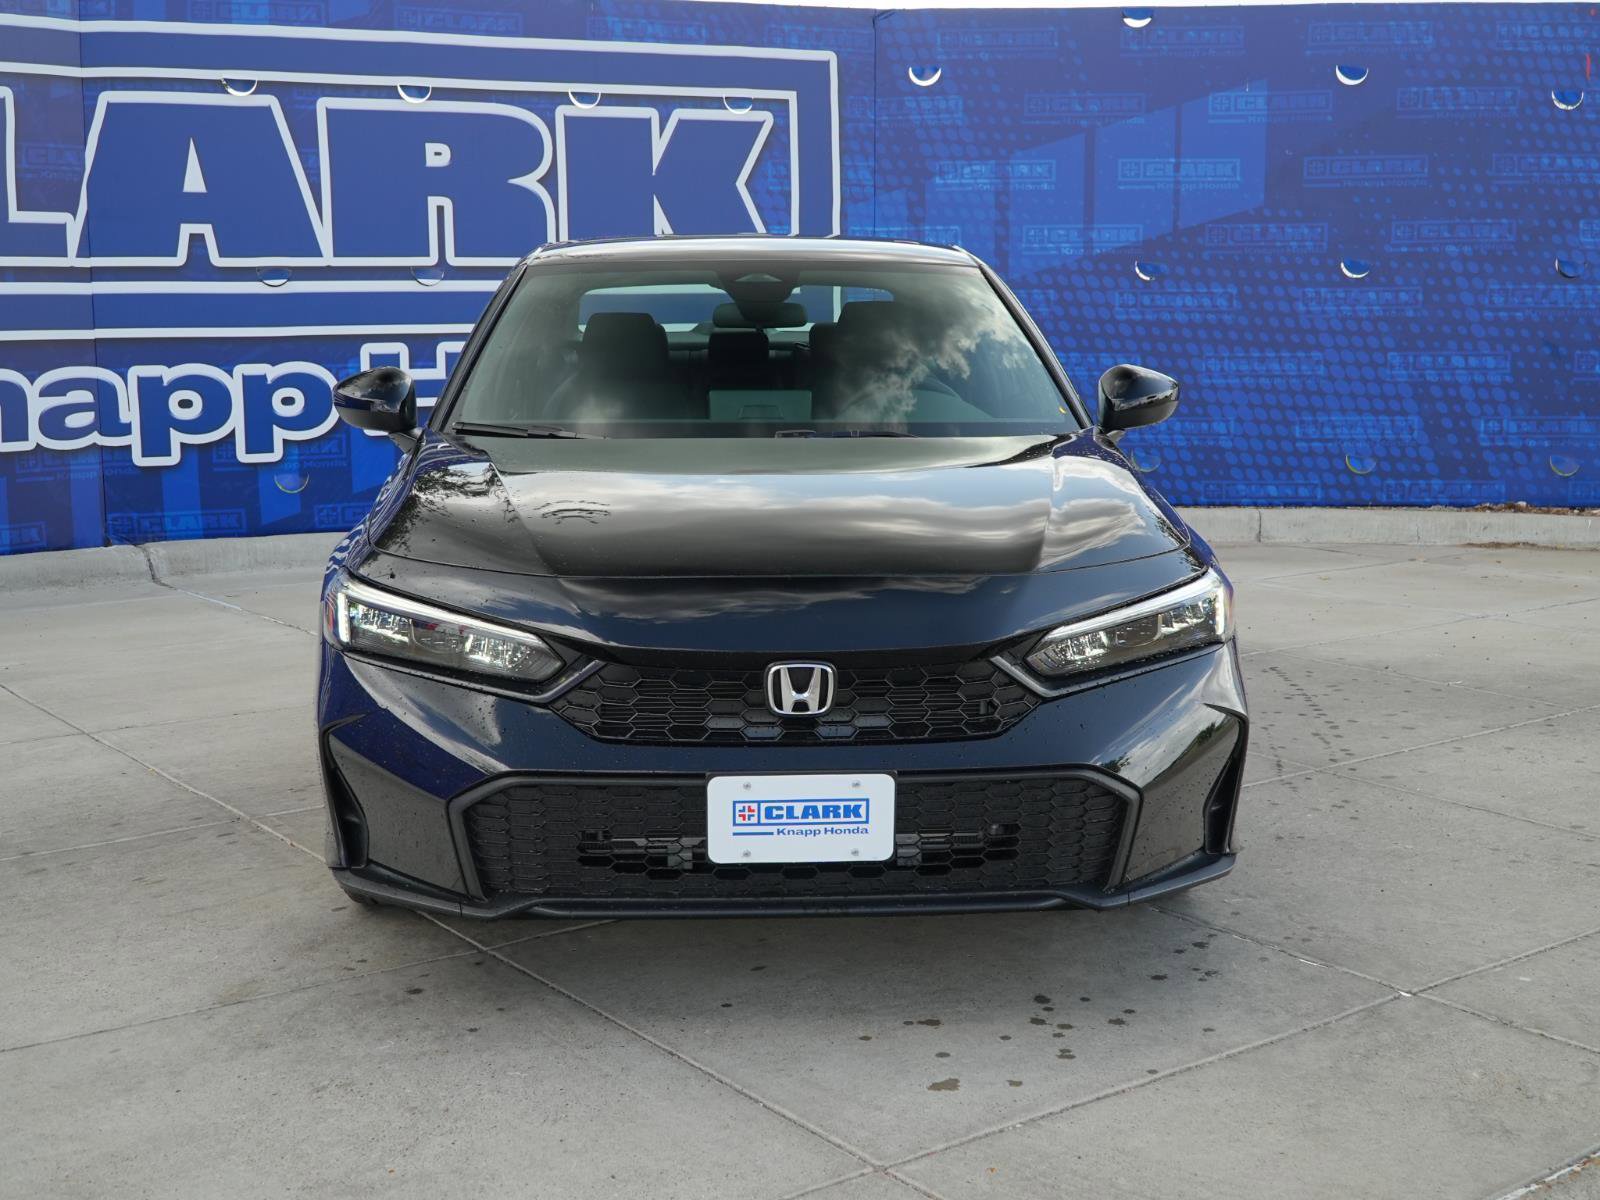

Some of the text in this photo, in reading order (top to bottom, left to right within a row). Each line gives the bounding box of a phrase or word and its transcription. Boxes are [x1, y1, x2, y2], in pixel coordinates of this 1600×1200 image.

[764, 804, 863, 820] CLARK
[776, 826, 869, 837] Knapp Honda
